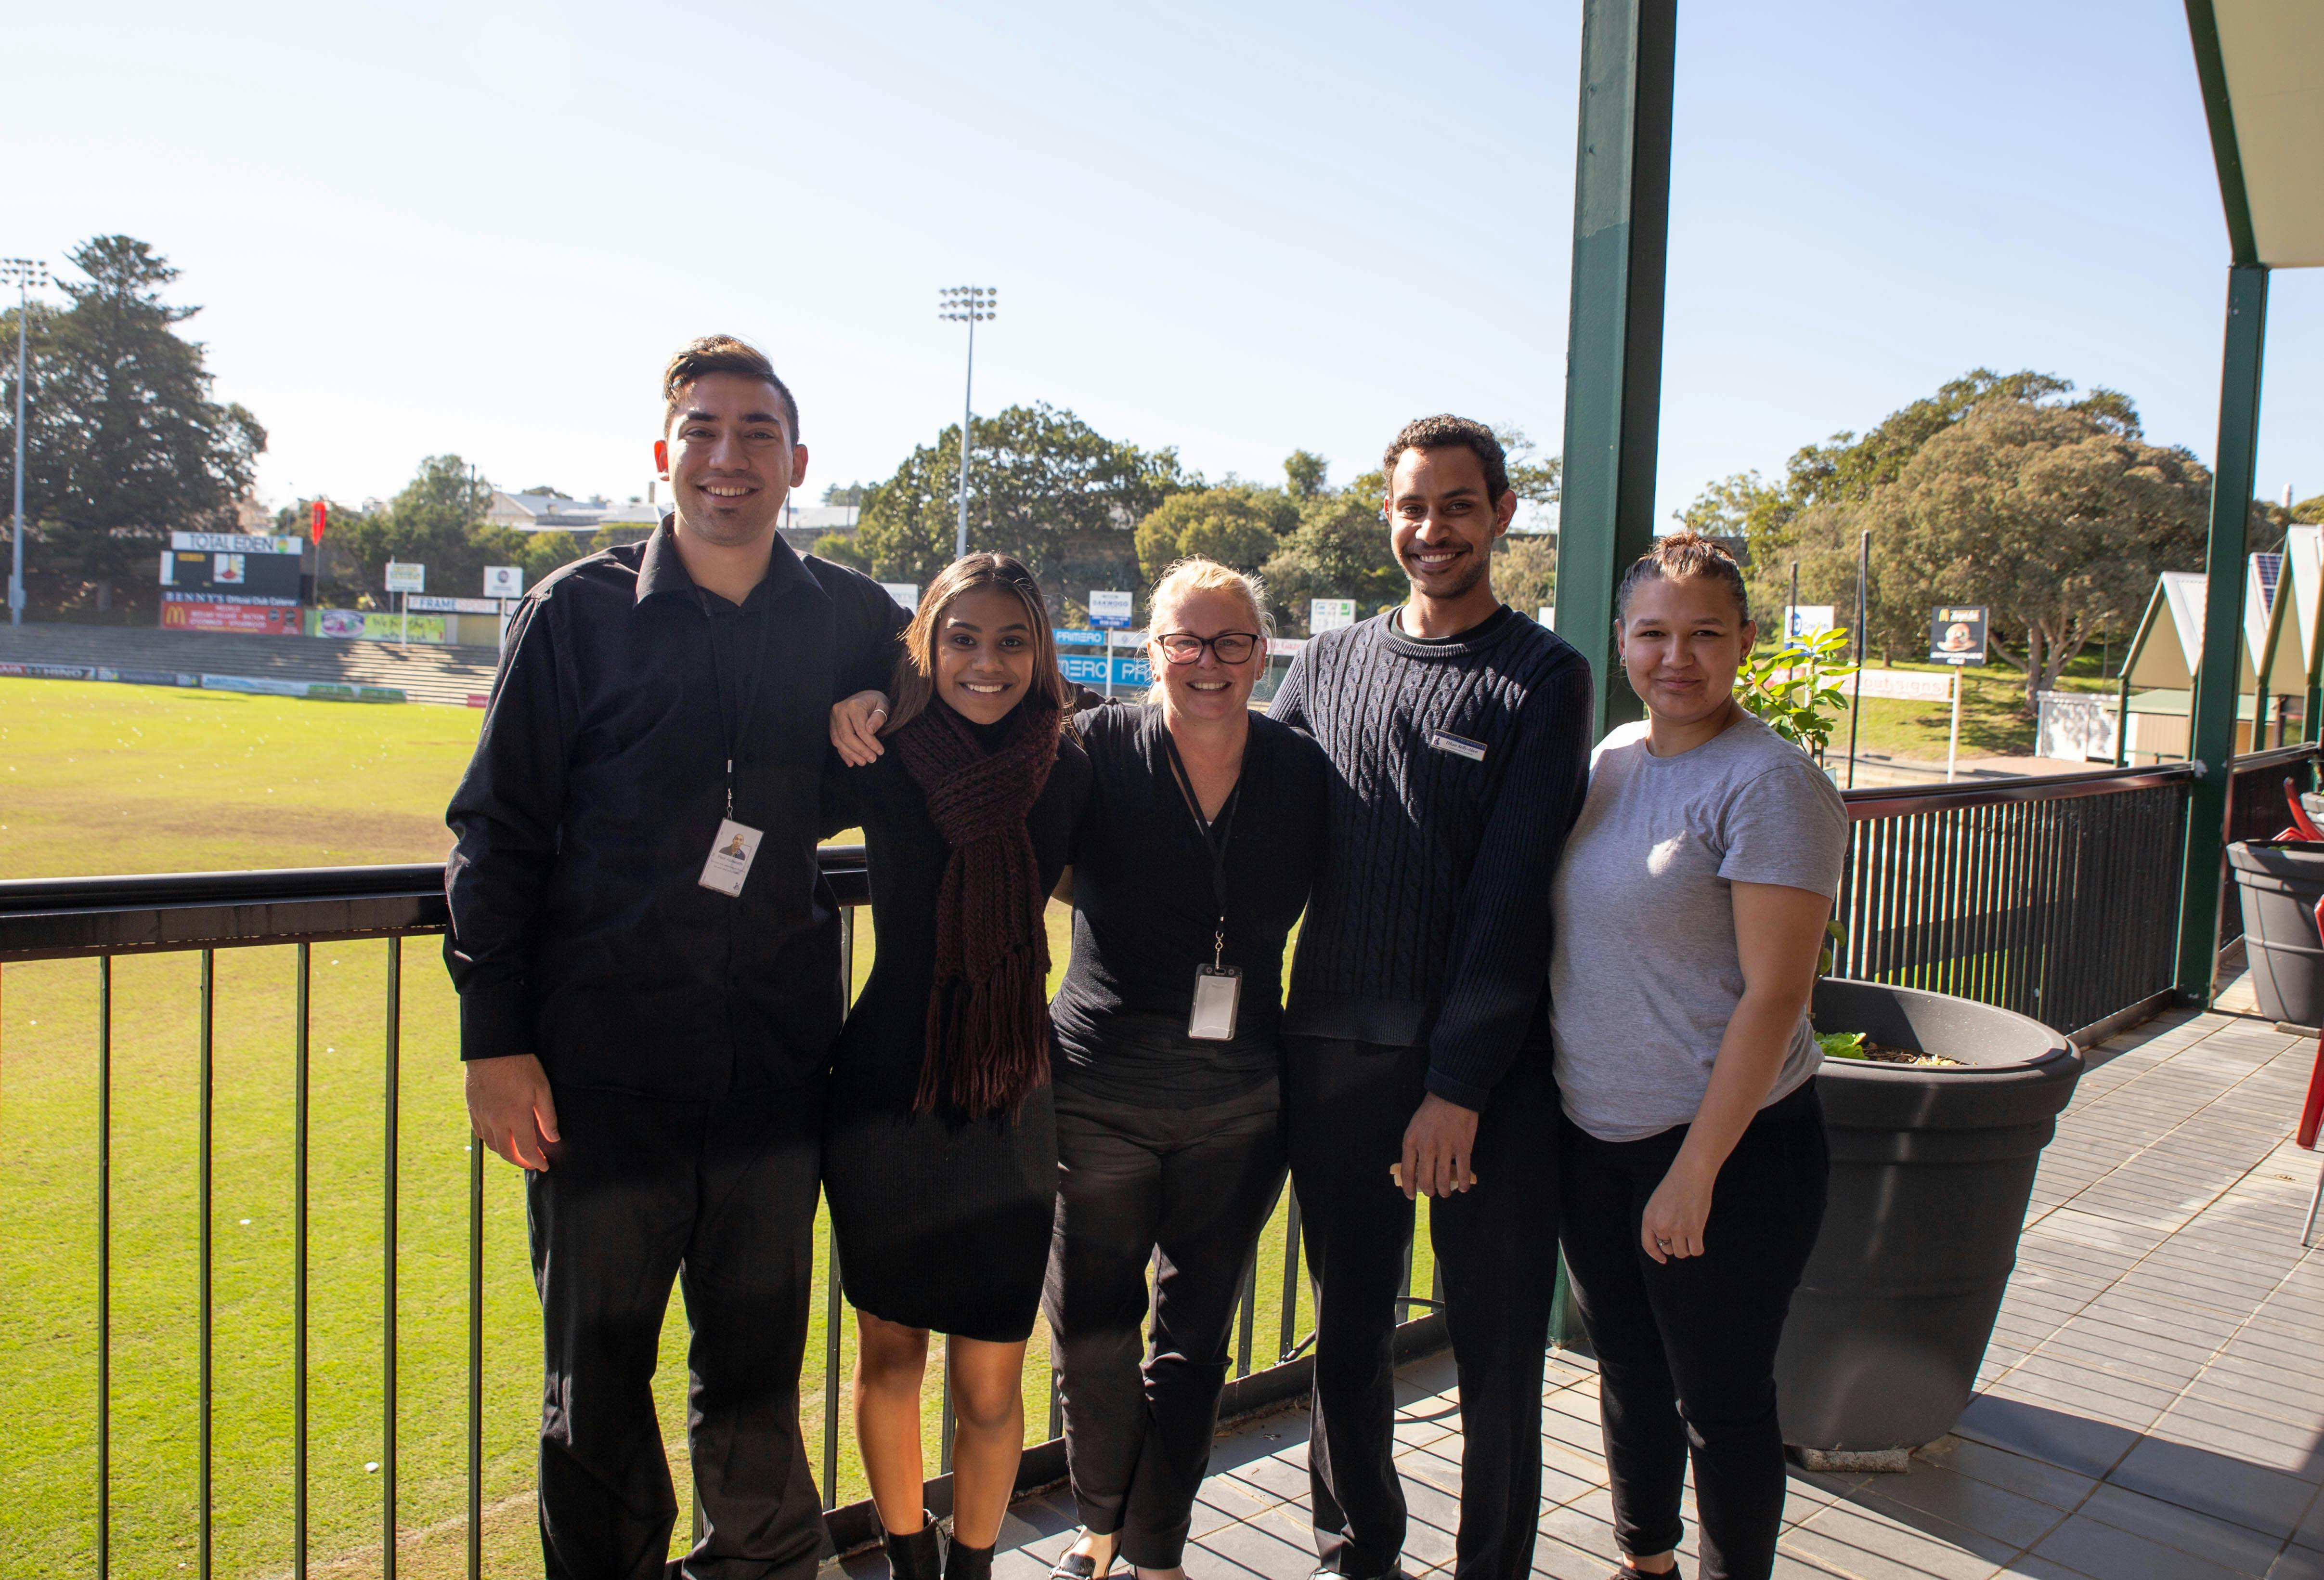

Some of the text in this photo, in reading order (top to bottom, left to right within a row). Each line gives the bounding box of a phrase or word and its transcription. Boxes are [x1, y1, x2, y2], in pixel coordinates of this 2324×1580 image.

[191, 535, 274, 551] TOTAL EDEN
[166, 591, 224, 602] BENNY'S
[226, 595, 251, 605] Official
[253, 596, 269, 606] Club
[1056, 631, 1102, 643] PRIMERO
[1057, 660, 1150, 680] MERO PR
[1895, 679, 1942, 694] signs
